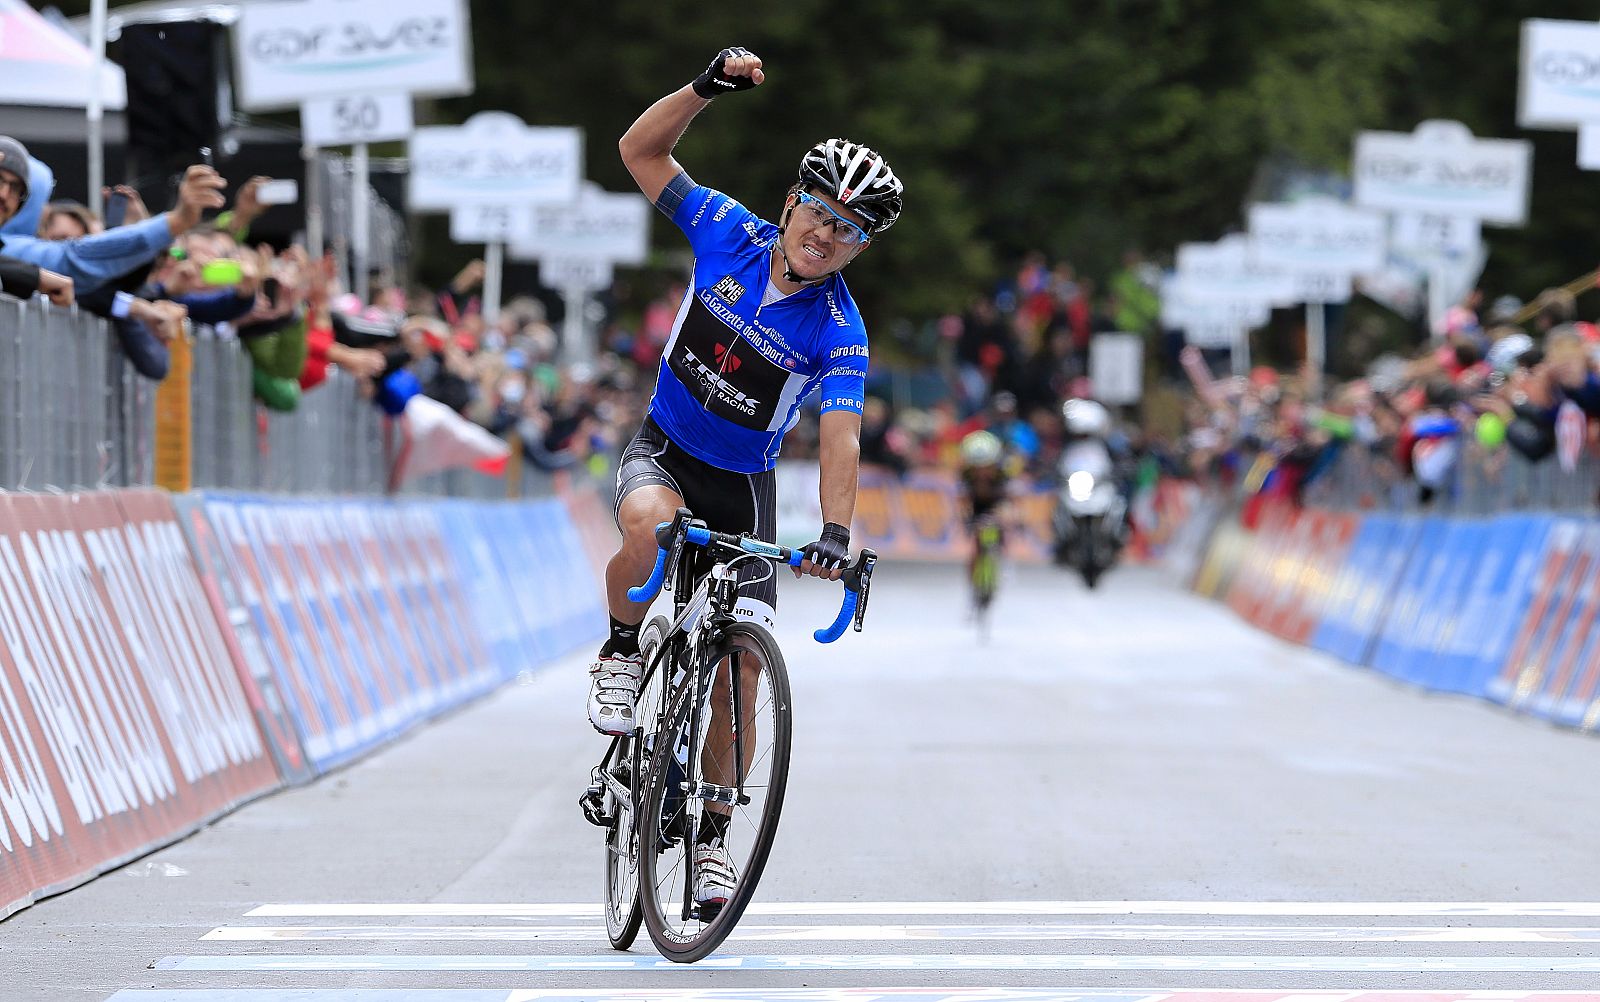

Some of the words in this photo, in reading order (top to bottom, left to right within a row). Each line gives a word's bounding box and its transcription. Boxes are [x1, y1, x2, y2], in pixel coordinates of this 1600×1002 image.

[713, 77, 737, 89] TREK
[335, 98, 380, 133] 50
[700, 288, 712, 304] La
[709, 296, 745, 331] Gazzetta
[742, 324, 763, 348] dello
[760, 339, 785, 364] Sport
[830, 346, 849, 359] Giro
[681, 358, 719, 395] FACTORY
[716, 391, 756, 416] RACING
[685, 345, 761, 409] TREK
[836, 397, 854, 407] FOR
